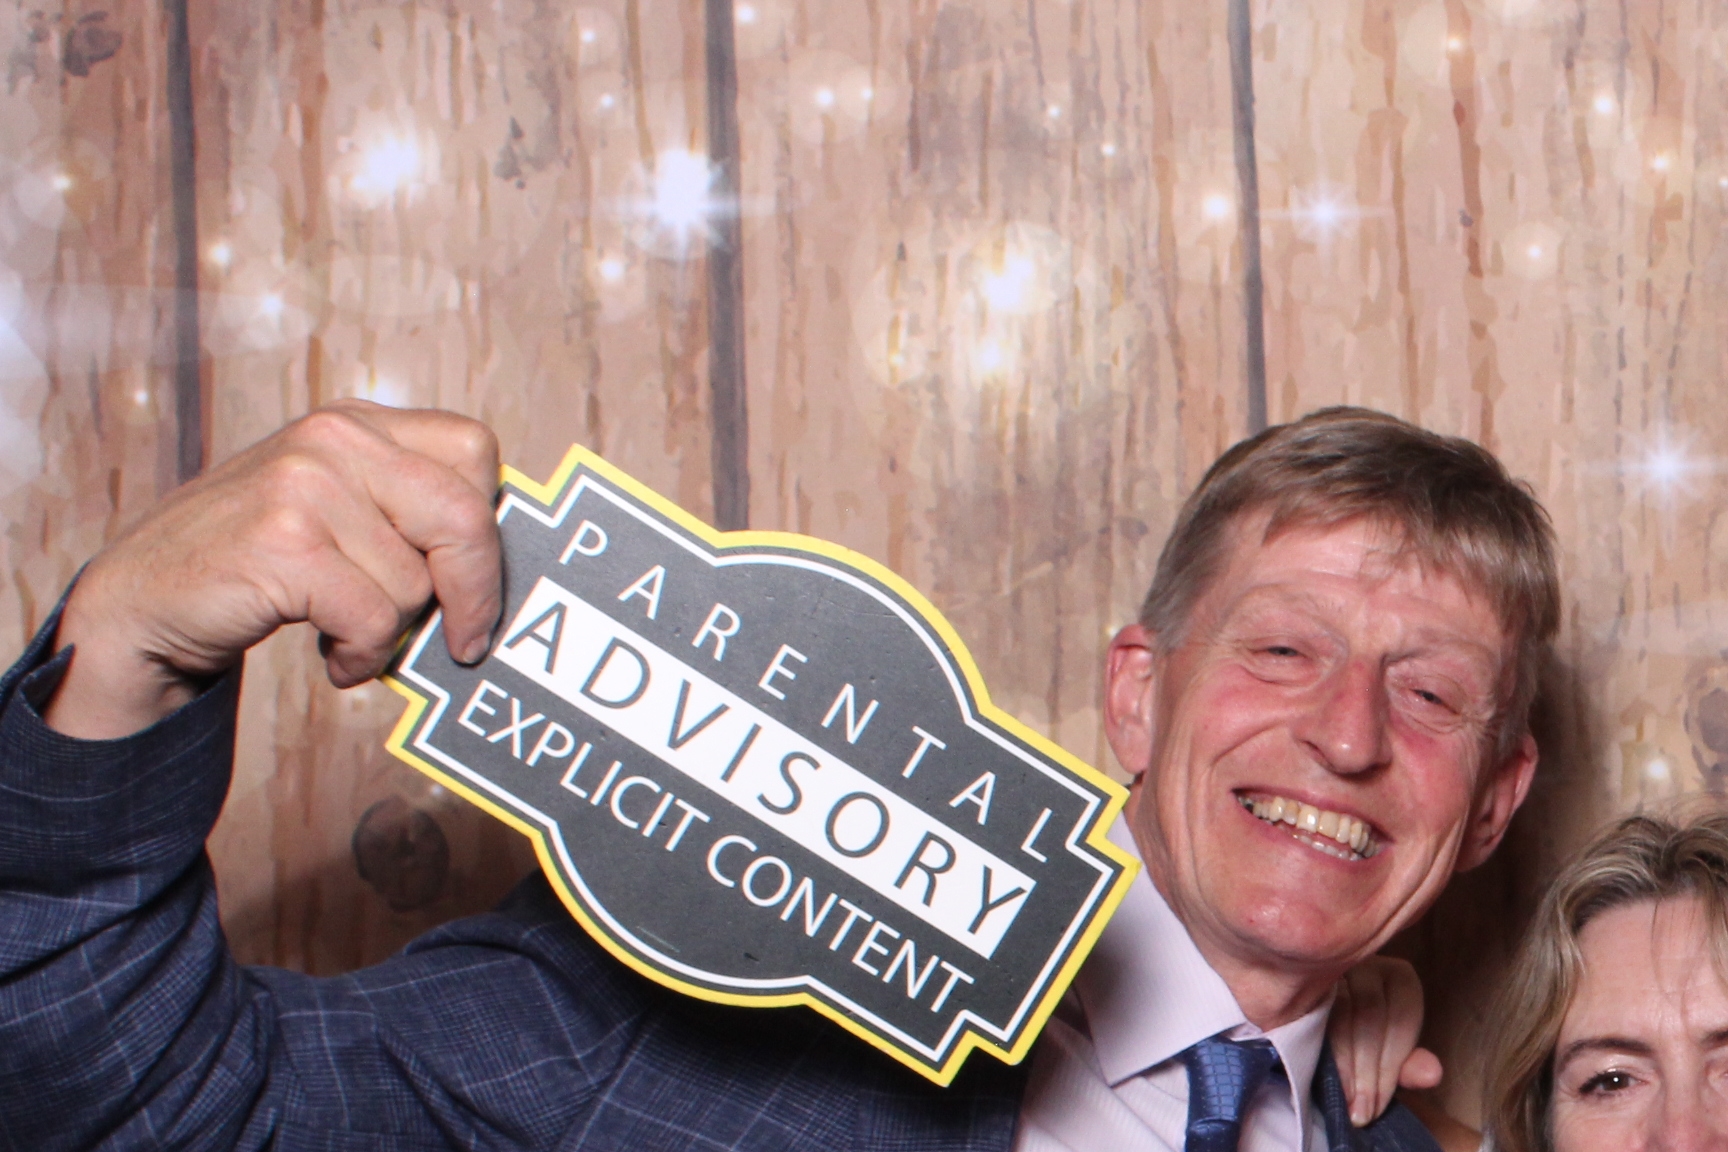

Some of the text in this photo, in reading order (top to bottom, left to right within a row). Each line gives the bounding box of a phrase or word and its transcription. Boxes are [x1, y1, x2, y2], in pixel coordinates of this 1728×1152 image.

[457, 678, 975, 1013] EXPLICIT CONTENT
[502, 600, 1027, 939] ADVISORY
[558, 519, 1053, 863] PARENTAL
